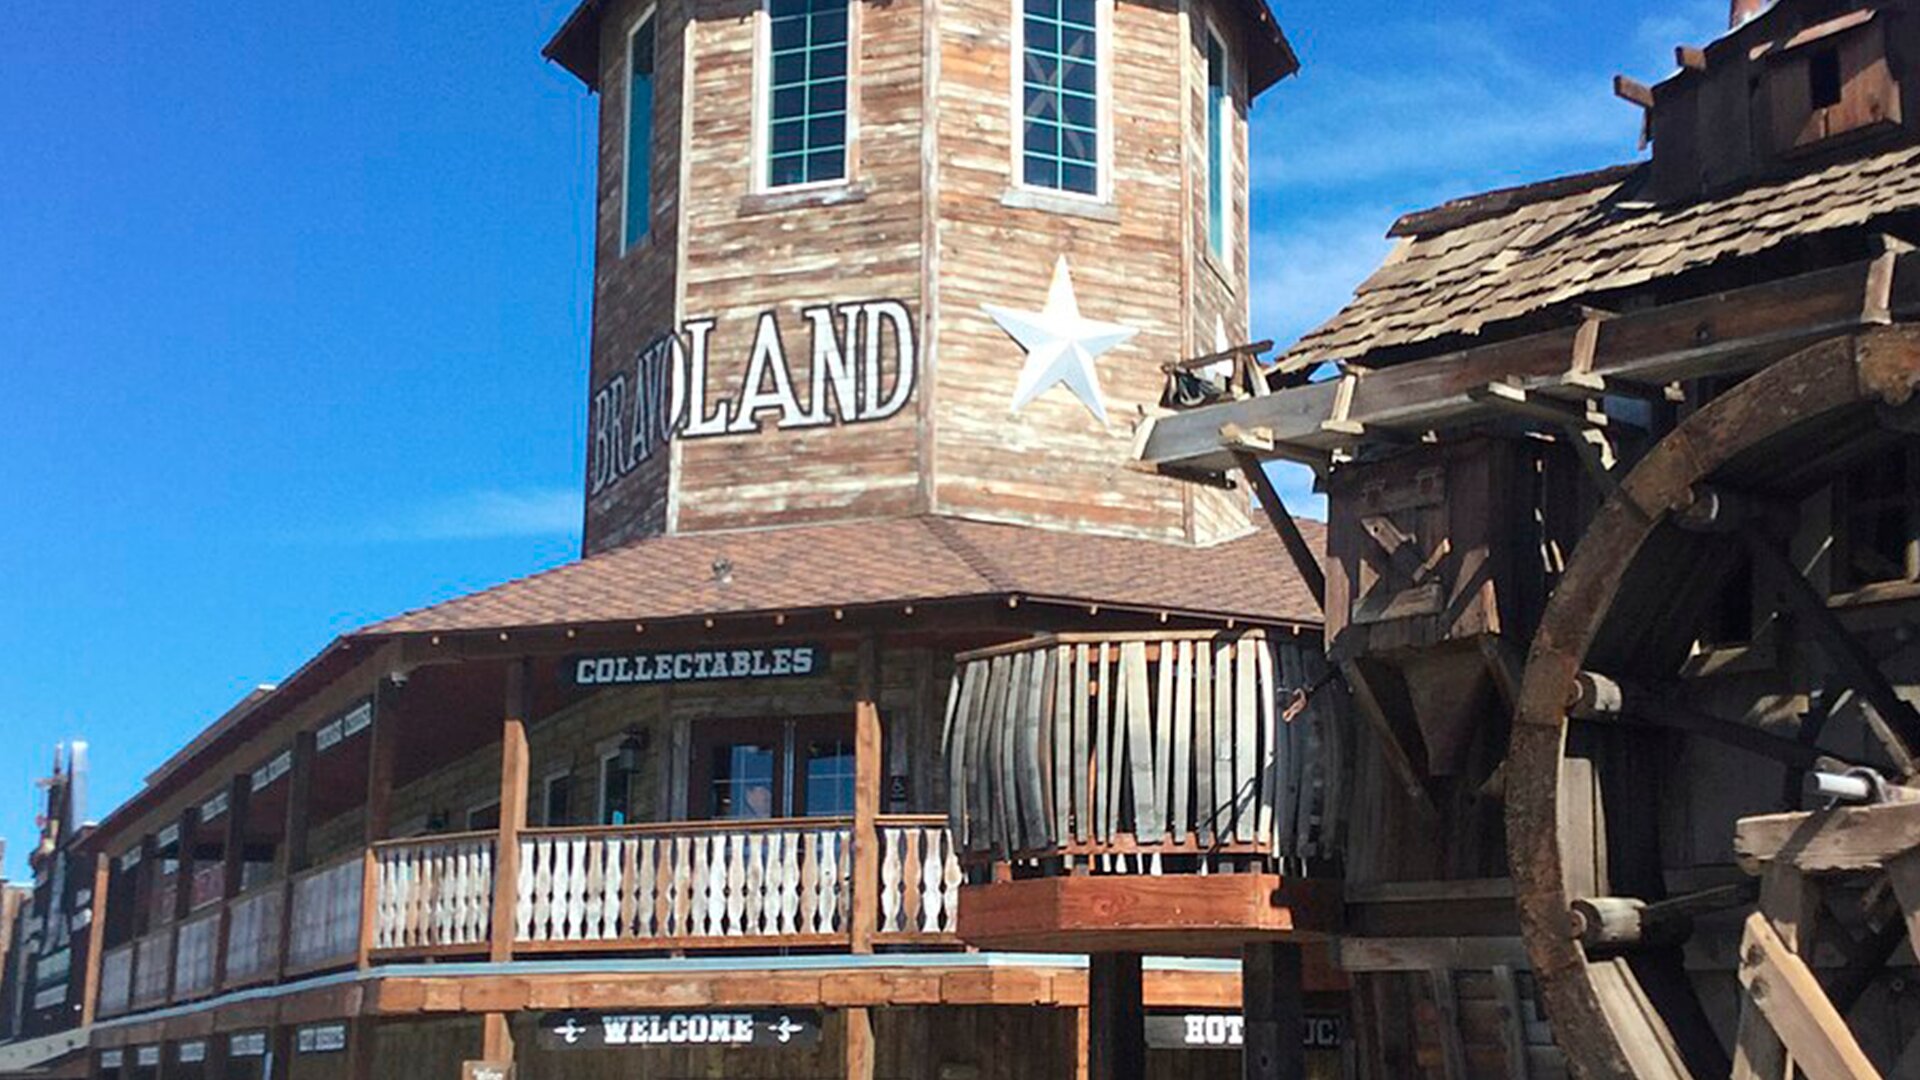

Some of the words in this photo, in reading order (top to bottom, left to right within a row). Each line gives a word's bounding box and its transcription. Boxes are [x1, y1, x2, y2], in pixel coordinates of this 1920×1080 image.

[576, 647, 814, 684] COLLECTABLES
[601, 1013, 754, 1044] WELCOME
[1184, 1014, 1244, 1045] HOT
